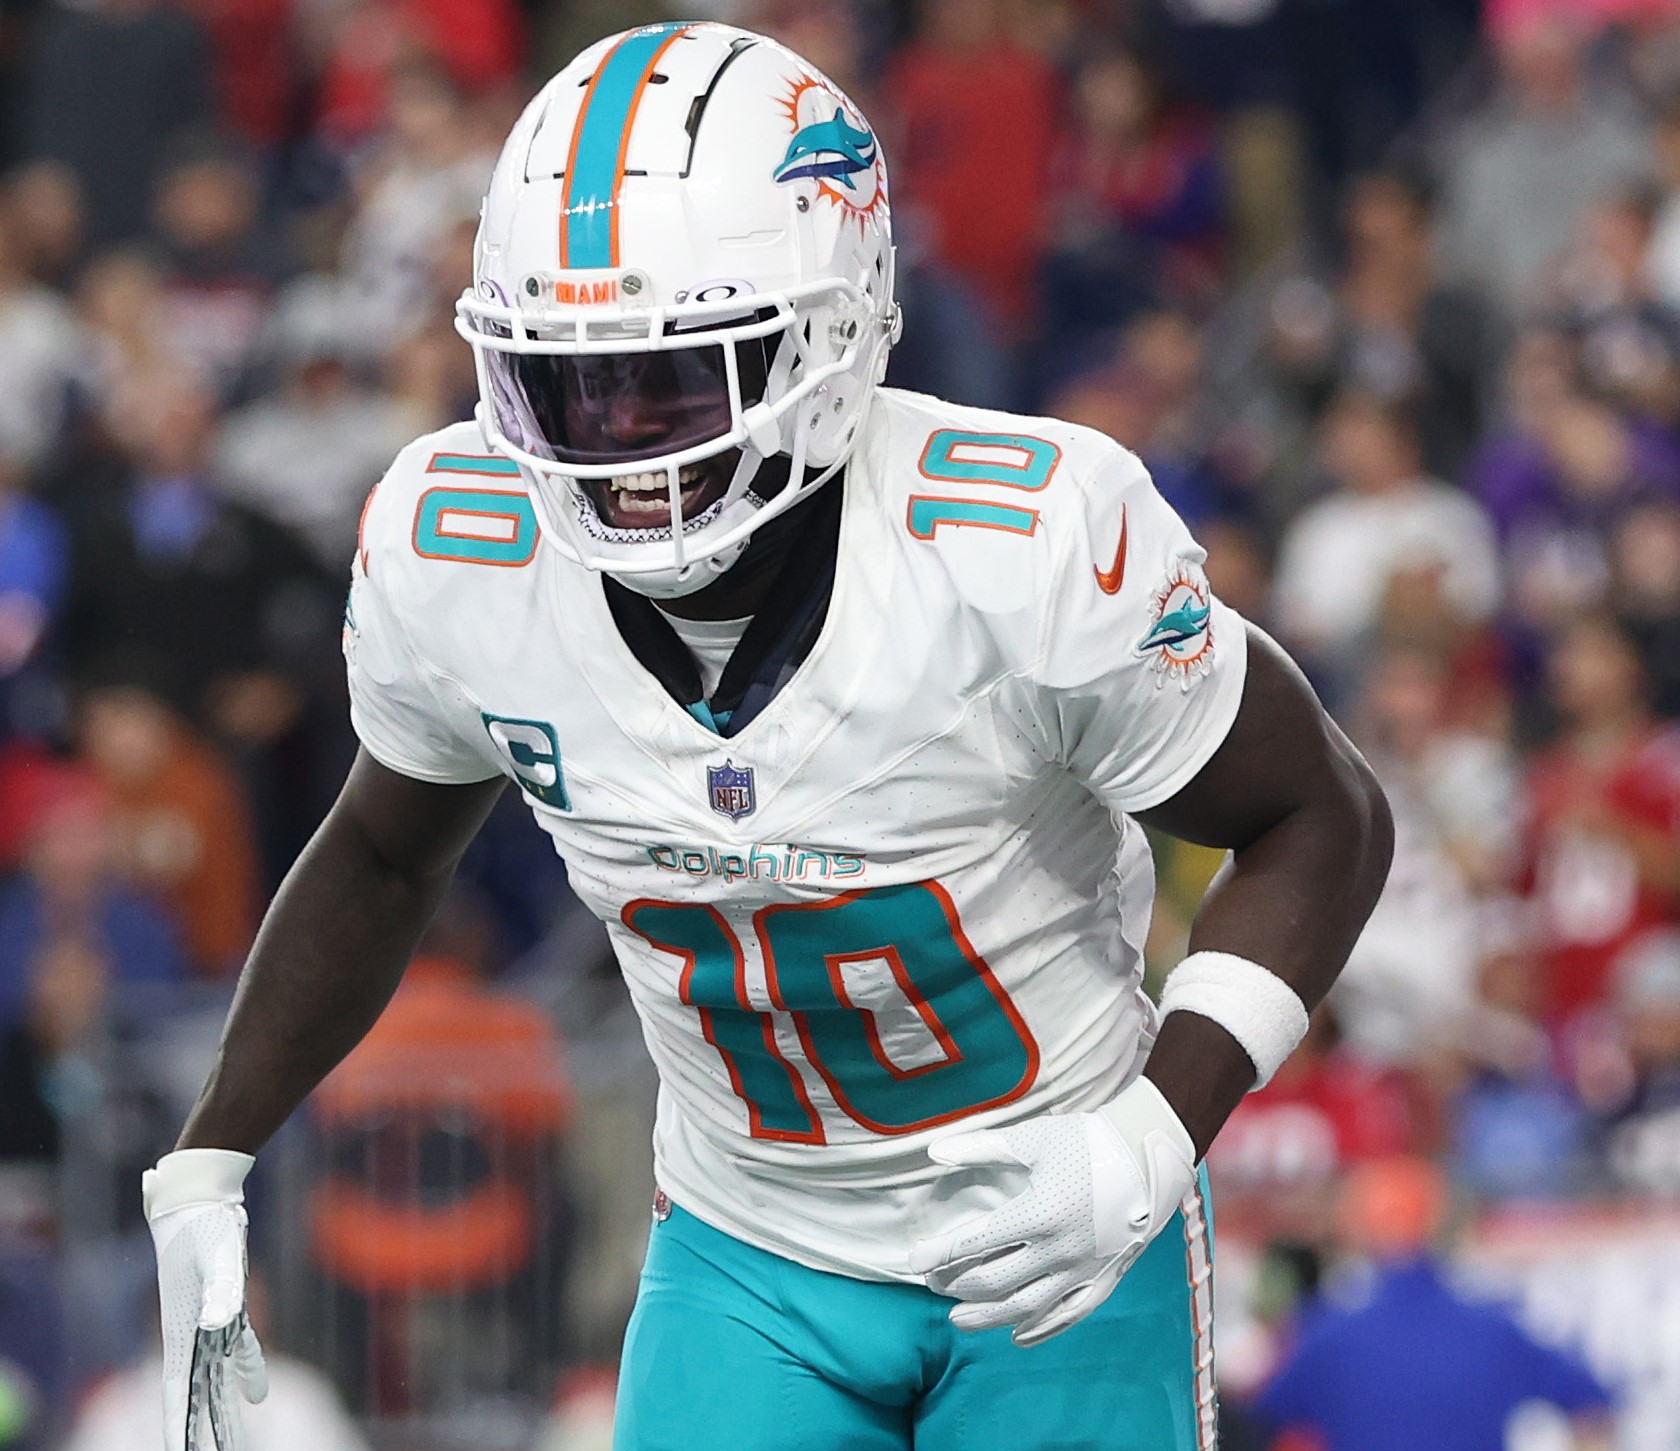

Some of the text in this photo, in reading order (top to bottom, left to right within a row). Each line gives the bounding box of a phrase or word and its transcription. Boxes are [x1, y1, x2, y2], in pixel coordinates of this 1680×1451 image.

[906, 428, 1063, 540] 10
[714, 786, 749, 811] NFL
[647, 842, 868, 884] Dolphins
[621, 878, 1040, 1146] 10
